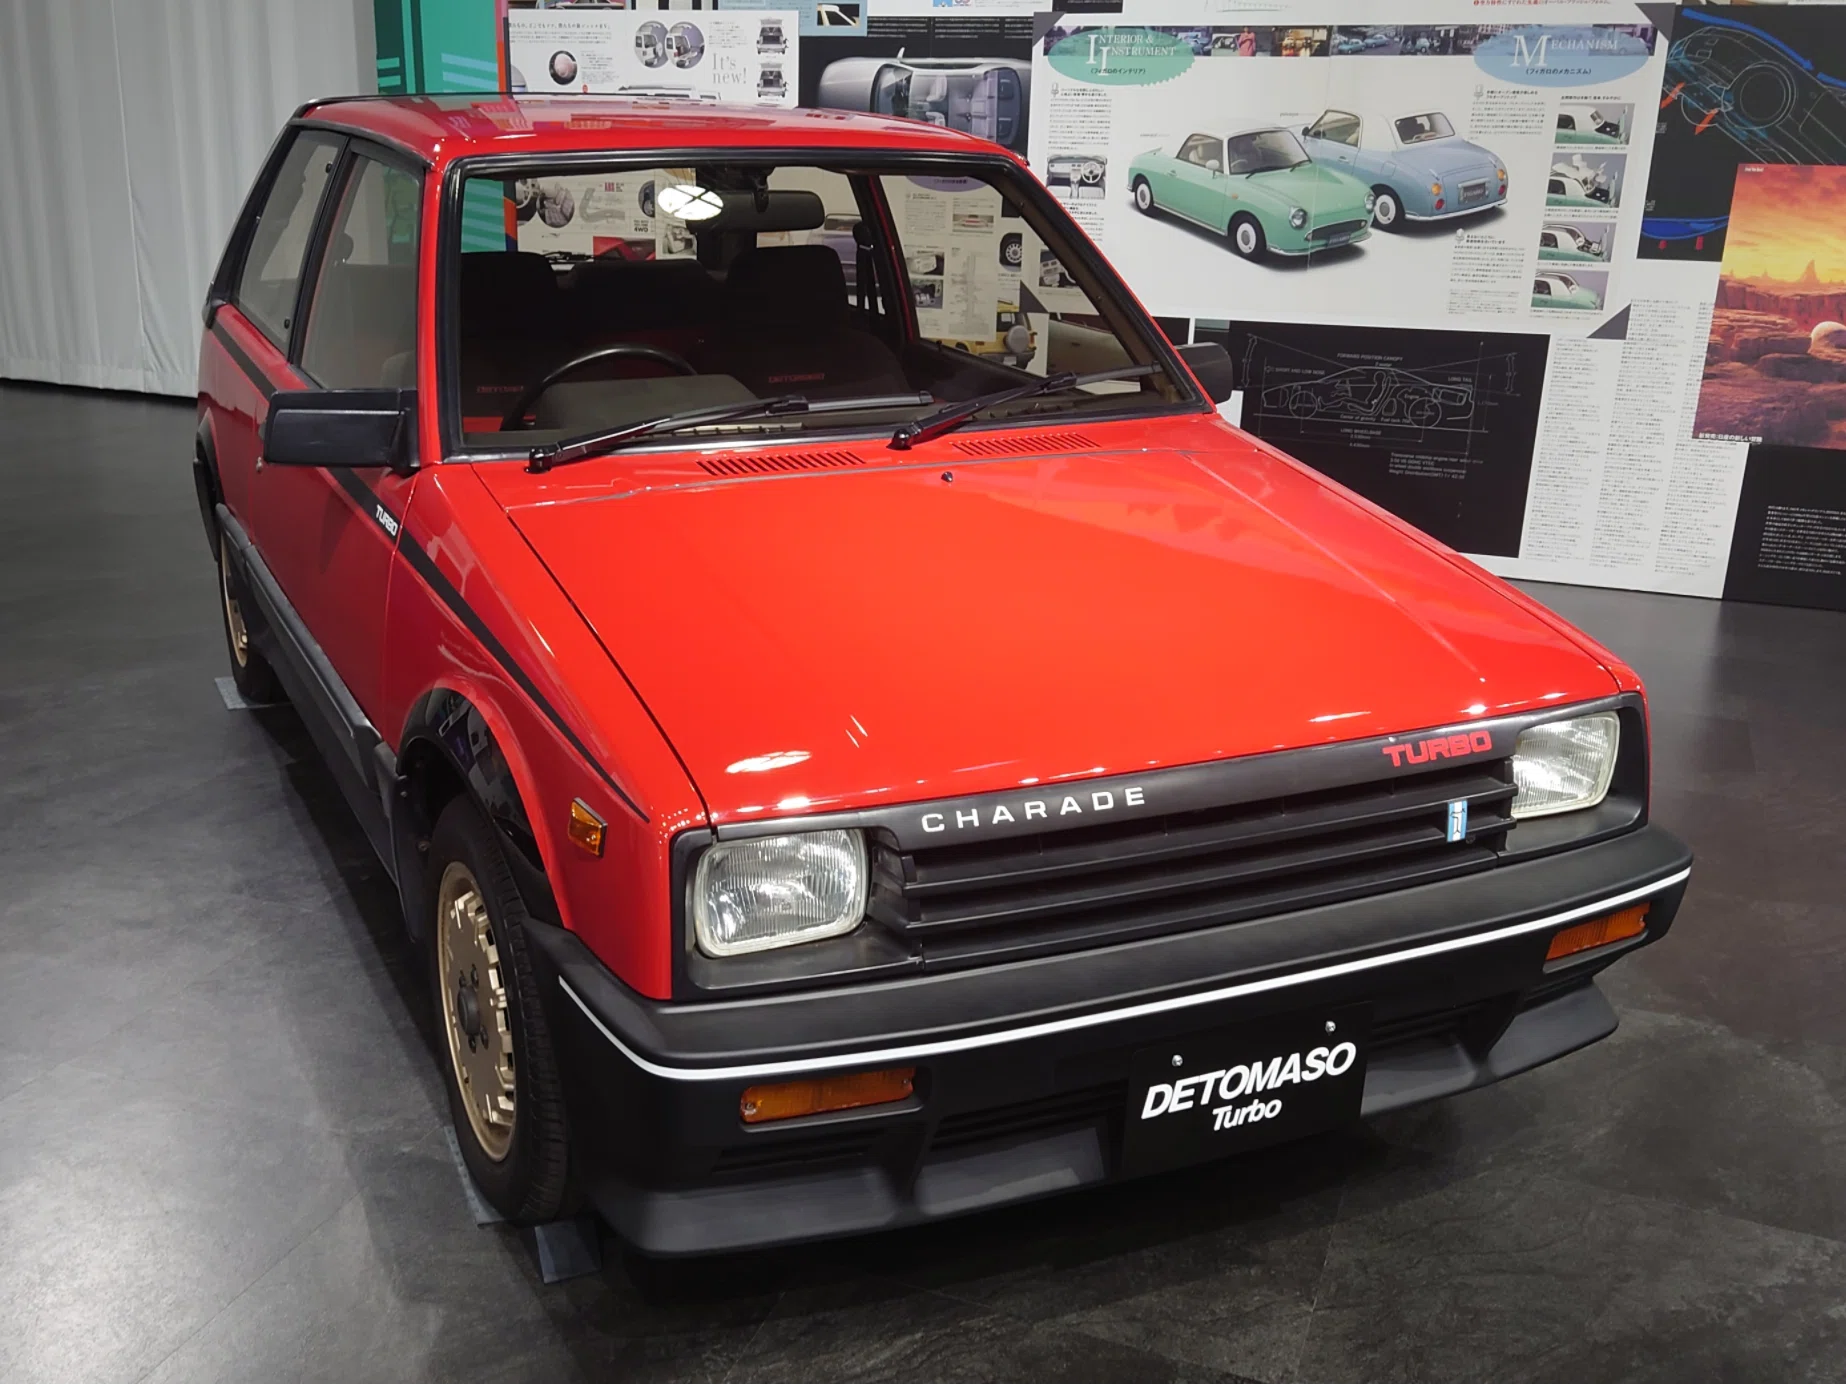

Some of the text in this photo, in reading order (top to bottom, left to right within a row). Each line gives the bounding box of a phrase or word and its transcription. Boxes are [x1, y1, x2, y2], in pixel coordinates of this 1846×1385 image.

[1145, 34, 1155, 45] &
[1510, 34, 1618, 68] MECHANISM
[712, 52, 737, 70] It's
[712, 67, 747, 84] new!
[375, 504, 399, 537] TURBO
[1382, 730, 1493, 768] TURBO
[921, 786, 1145, 833] CHARADE
[1141, 1041, 1357, 1119] DETOMASO
[1212, 1099, 1282, 1131] Turbo
